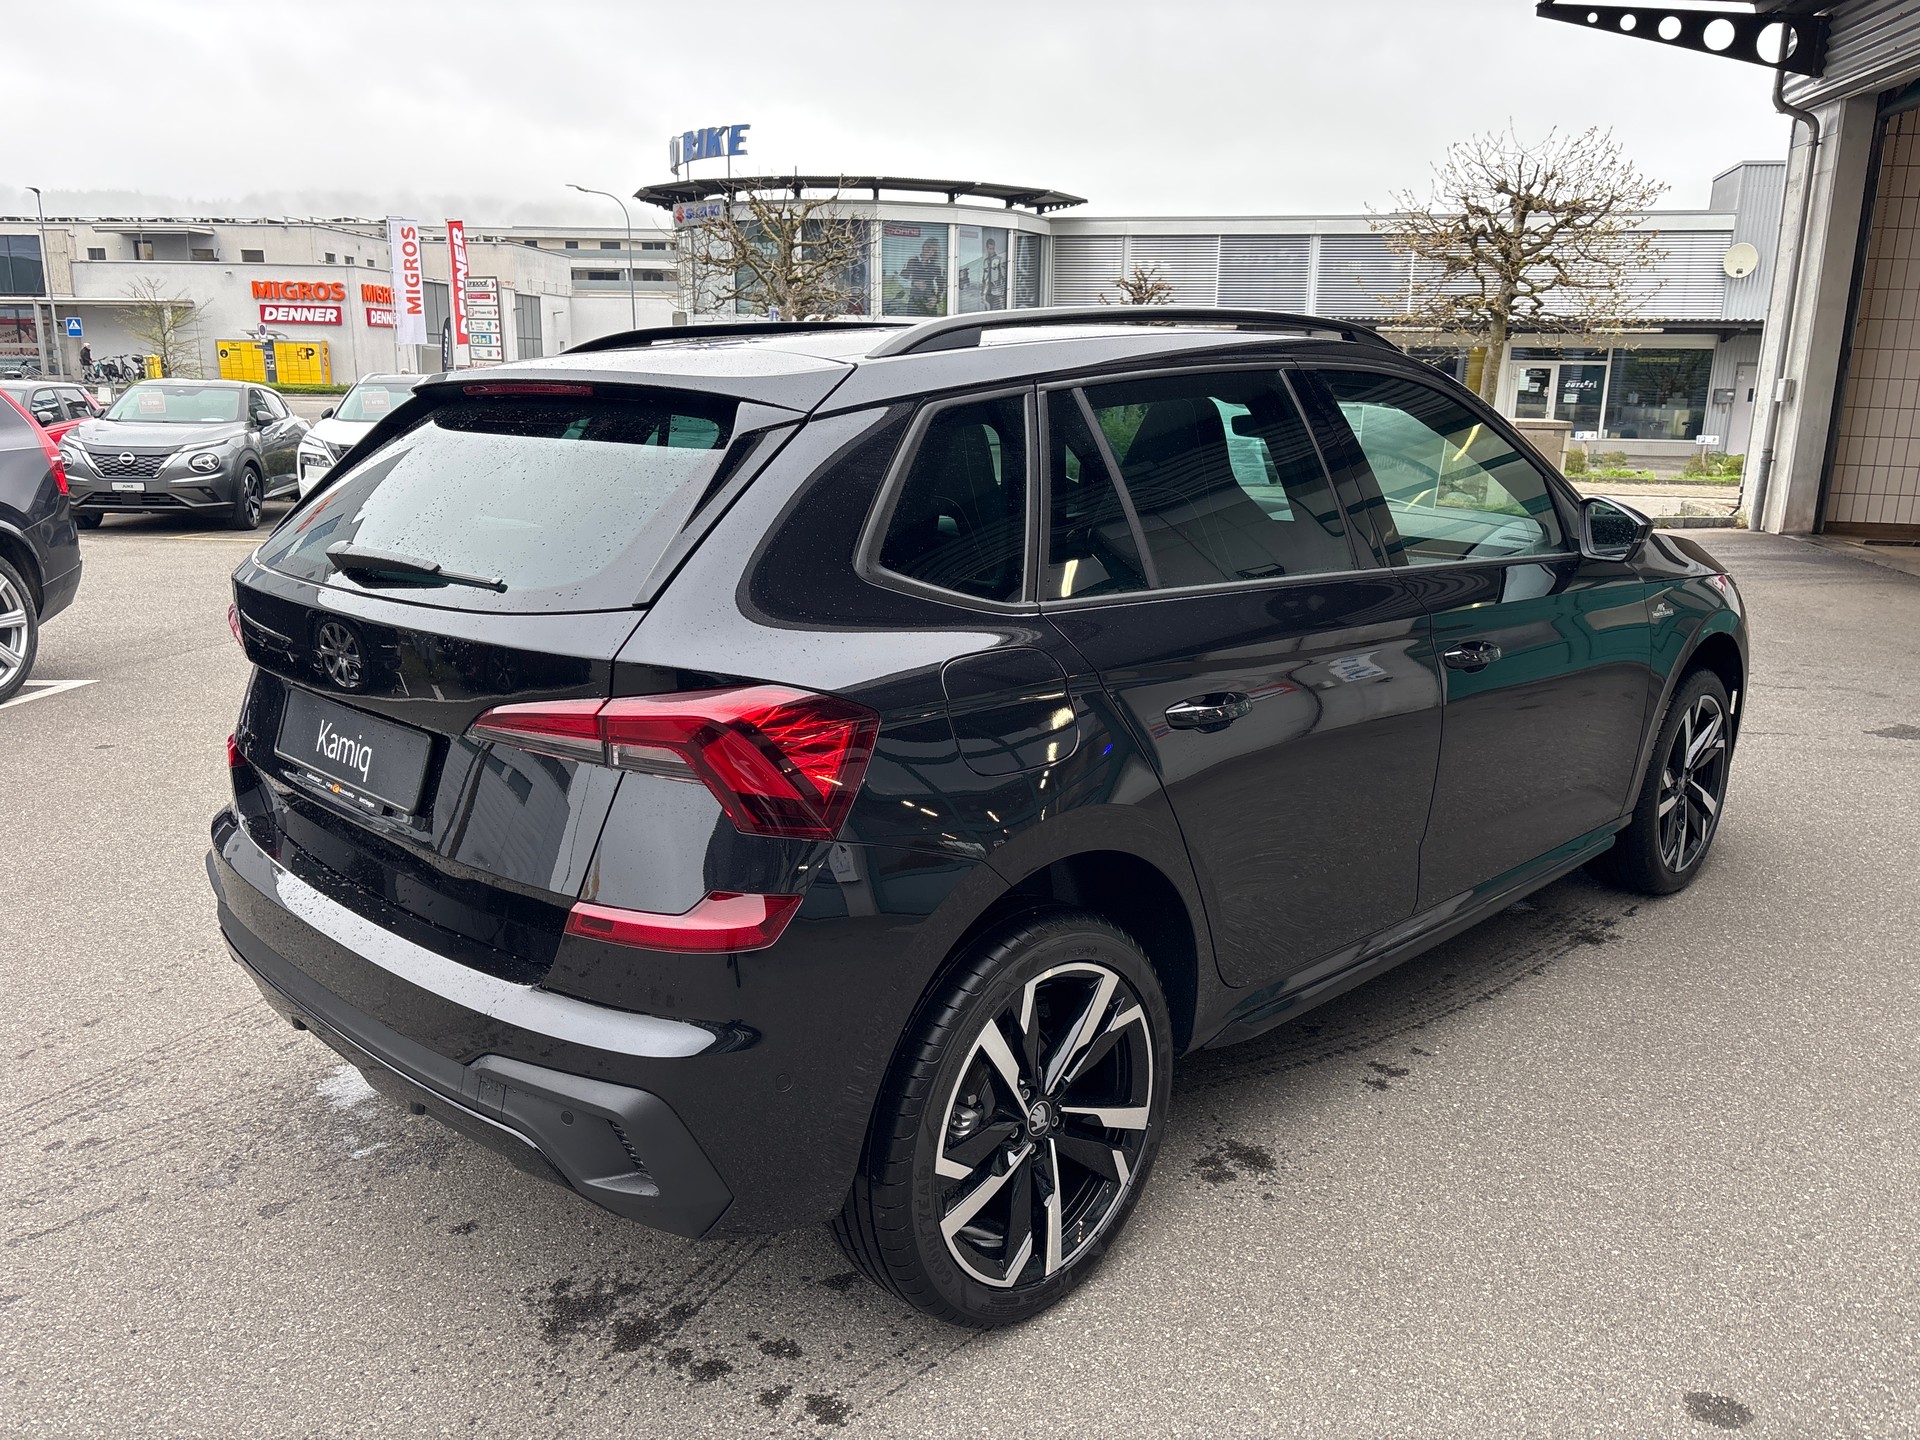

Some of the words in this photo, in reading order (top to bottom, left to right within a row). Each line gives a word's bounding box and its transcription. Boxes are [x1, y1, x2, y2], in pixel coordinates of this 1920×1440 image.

[683, 124, 751, 163] BIKE
[401, 226, 423, 315] MIGROS
[251, 281, 346, 301] MIGROS
[361, 284, 395, 304] MIGR
[264, 307, 338, 322] DENNER
[371, 311, 395, 324] DENN
[316, 719, 373, 783] Kamiq
